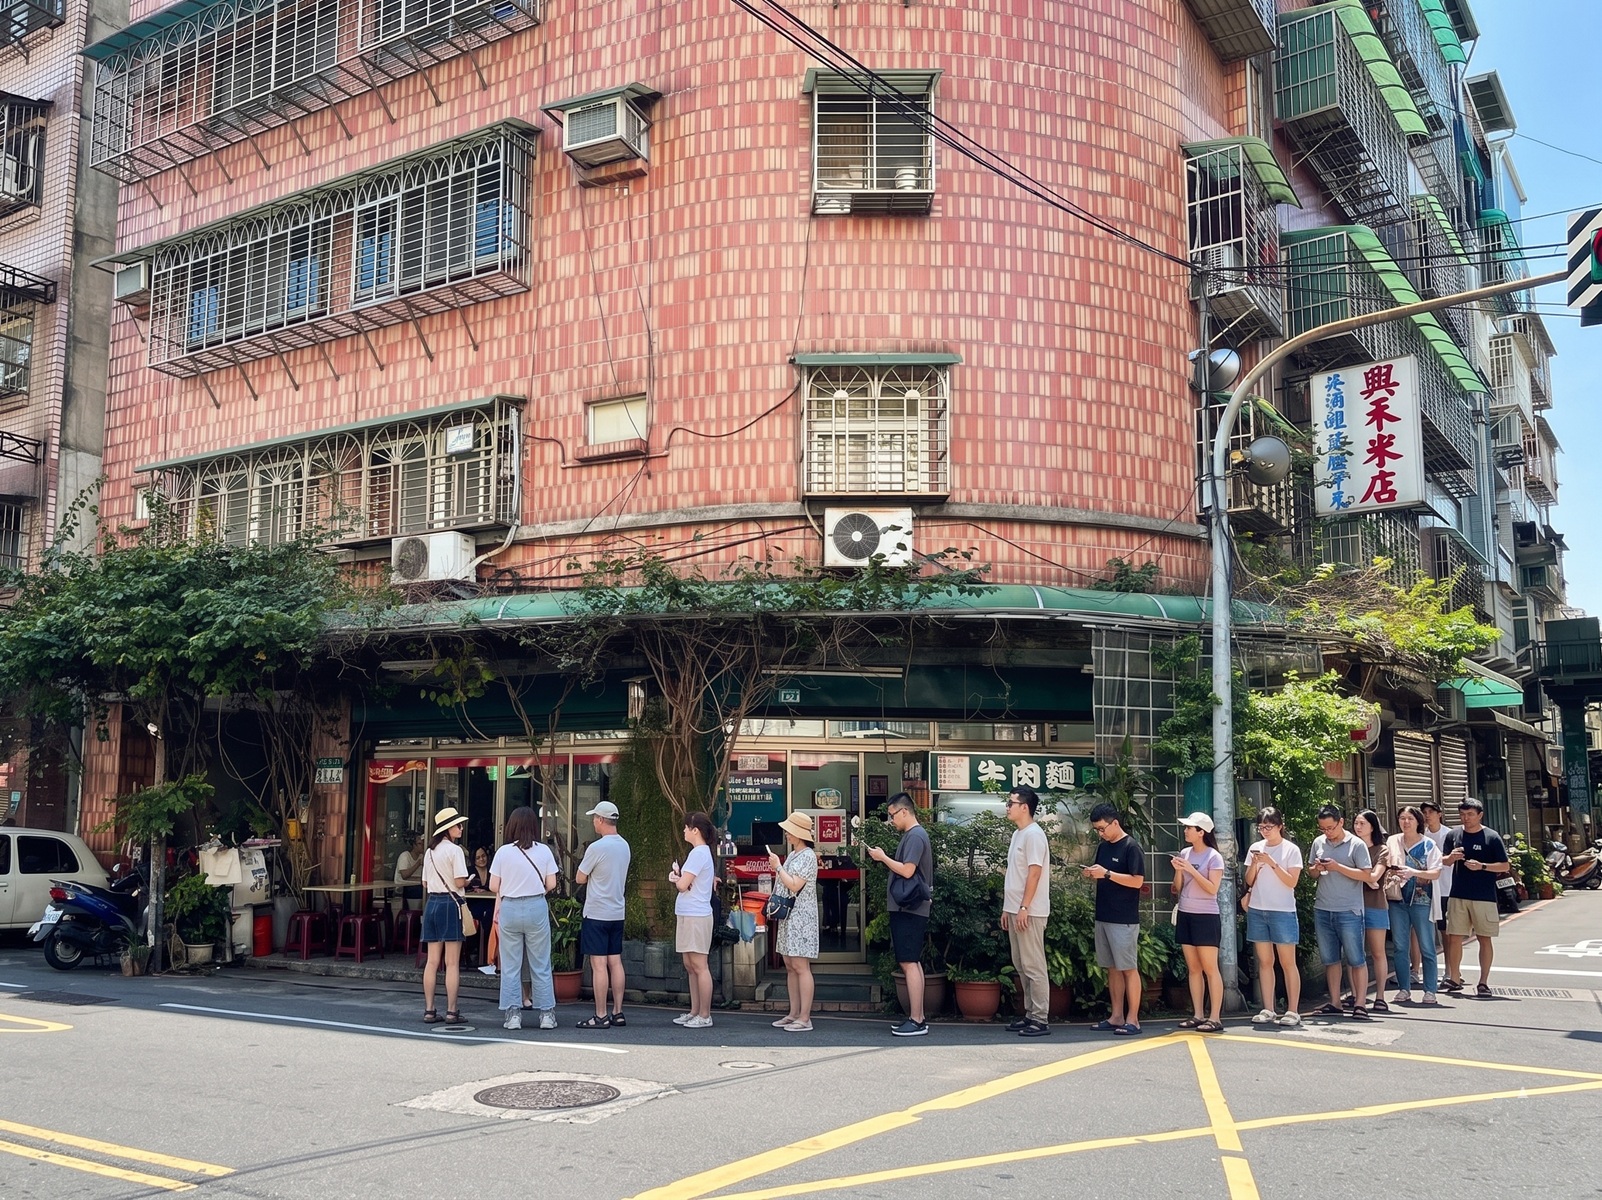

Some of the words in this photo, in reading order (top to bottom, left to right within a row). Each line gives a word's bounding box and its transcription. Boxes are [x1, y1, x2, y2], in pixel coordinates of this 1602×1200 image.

[1359, 363, 1404, 504] 興禾米店
[977, 759, 1076, 790] 牛肉麵
